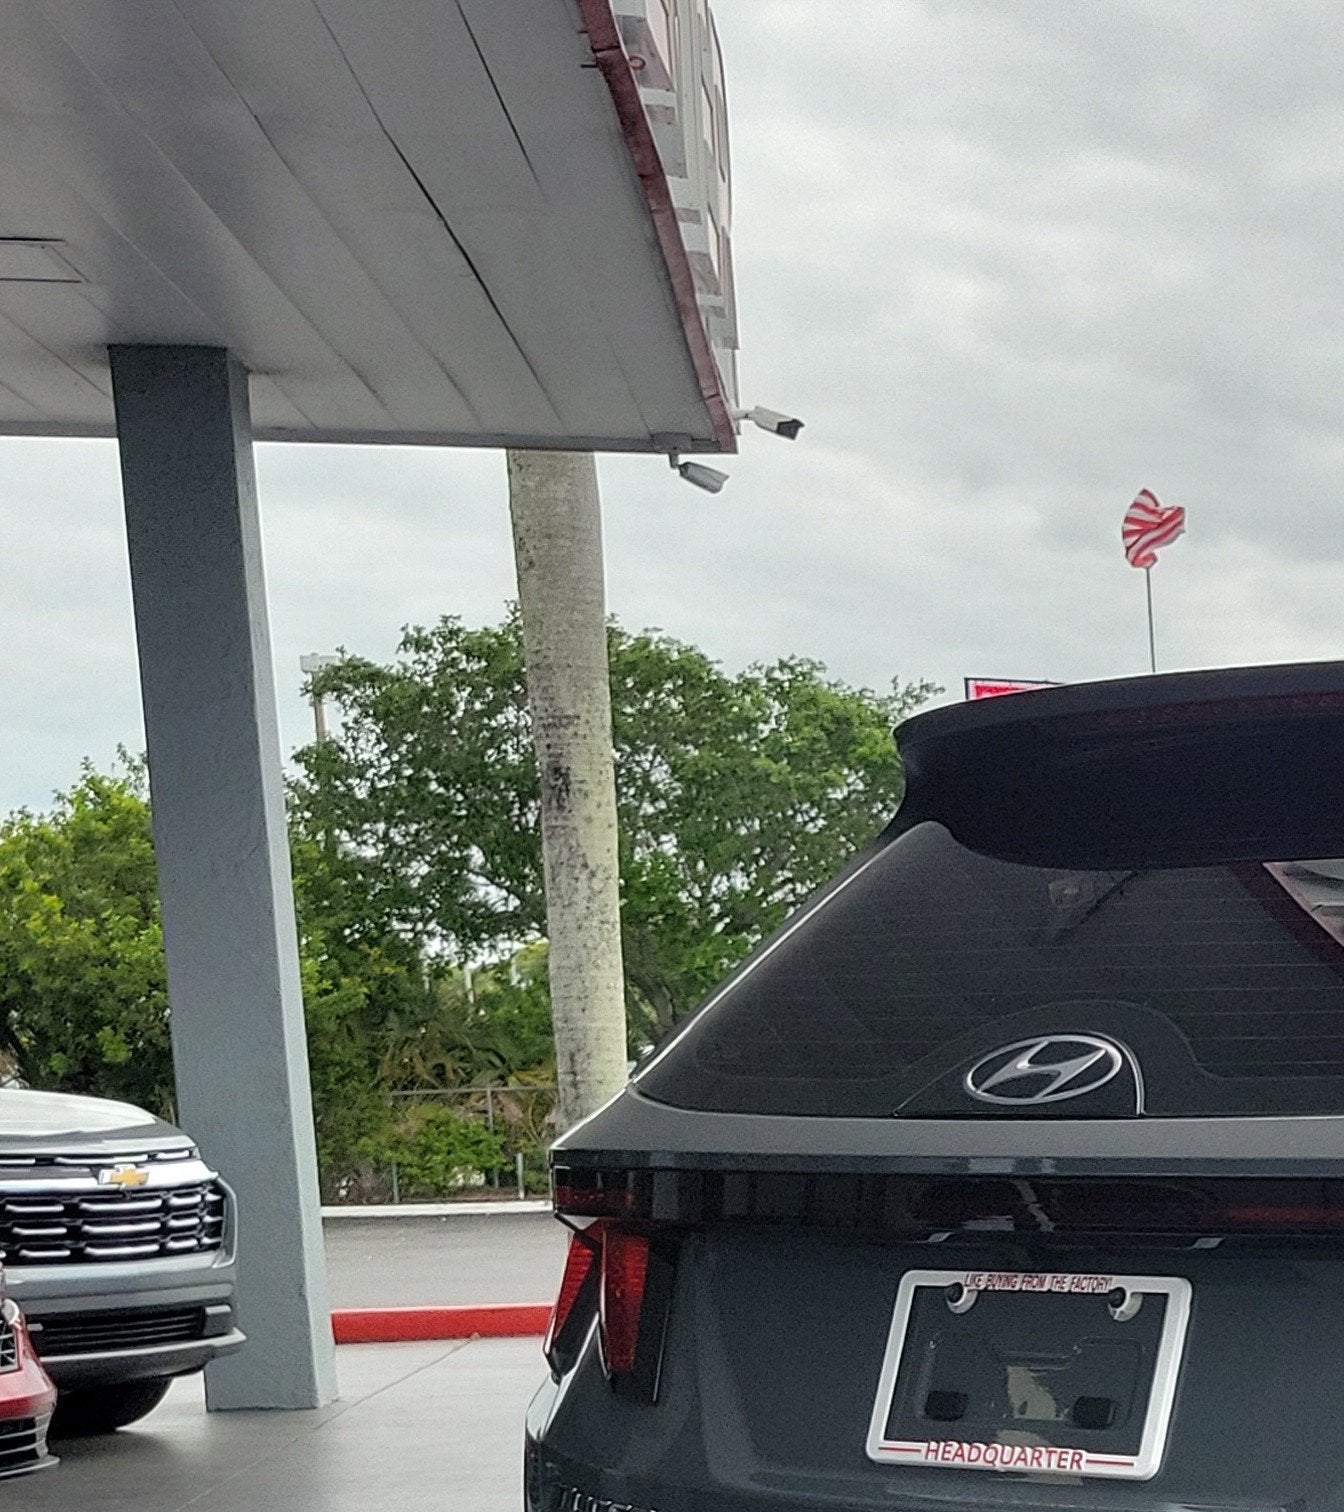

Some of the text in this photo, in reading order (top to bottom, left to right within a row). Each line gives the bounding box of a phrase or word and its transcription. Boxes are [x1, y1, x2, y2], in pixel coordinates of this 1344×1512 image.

[1021, 1275, 1047, 1289] FROM
[1051, 1276, 1067, 1290] THE
[925, 1441, 1083, 1471] HEADQUARTER
